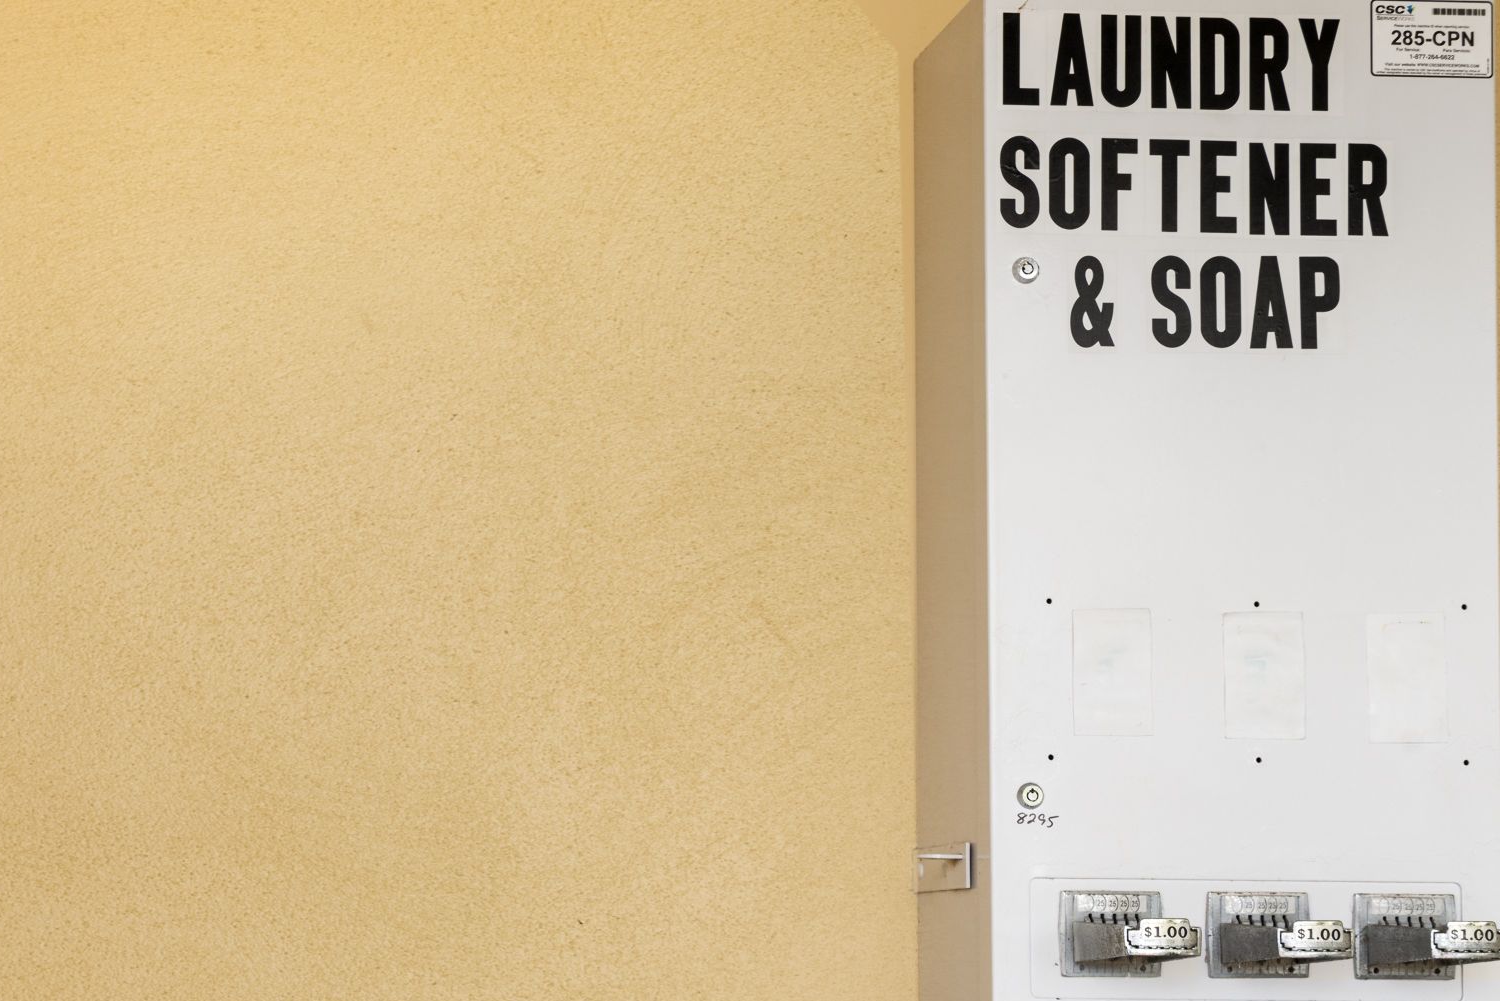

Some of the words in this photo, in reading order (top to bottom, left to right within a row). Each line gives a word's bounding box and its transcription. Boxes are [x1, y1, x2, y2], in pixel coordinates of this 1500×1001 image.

[1375, 5, 1406, 14] CSC
[1391, 30, 1475, 47] 285-CPN
[1002, 12, 1341, 111] LAUNDRY
[1000, 135, 1389, 237] SOFTENER
[1070, 255, 1115, 348] &
[1151, 255, 1341, 349] SOAP
[1016, 812, 1060, 828] 8295
[1144, 926, 1188, 938] $1.00
[1297, 928, 1341, 940] $1.00
[1451, 929, 1495, 941] $1.00
